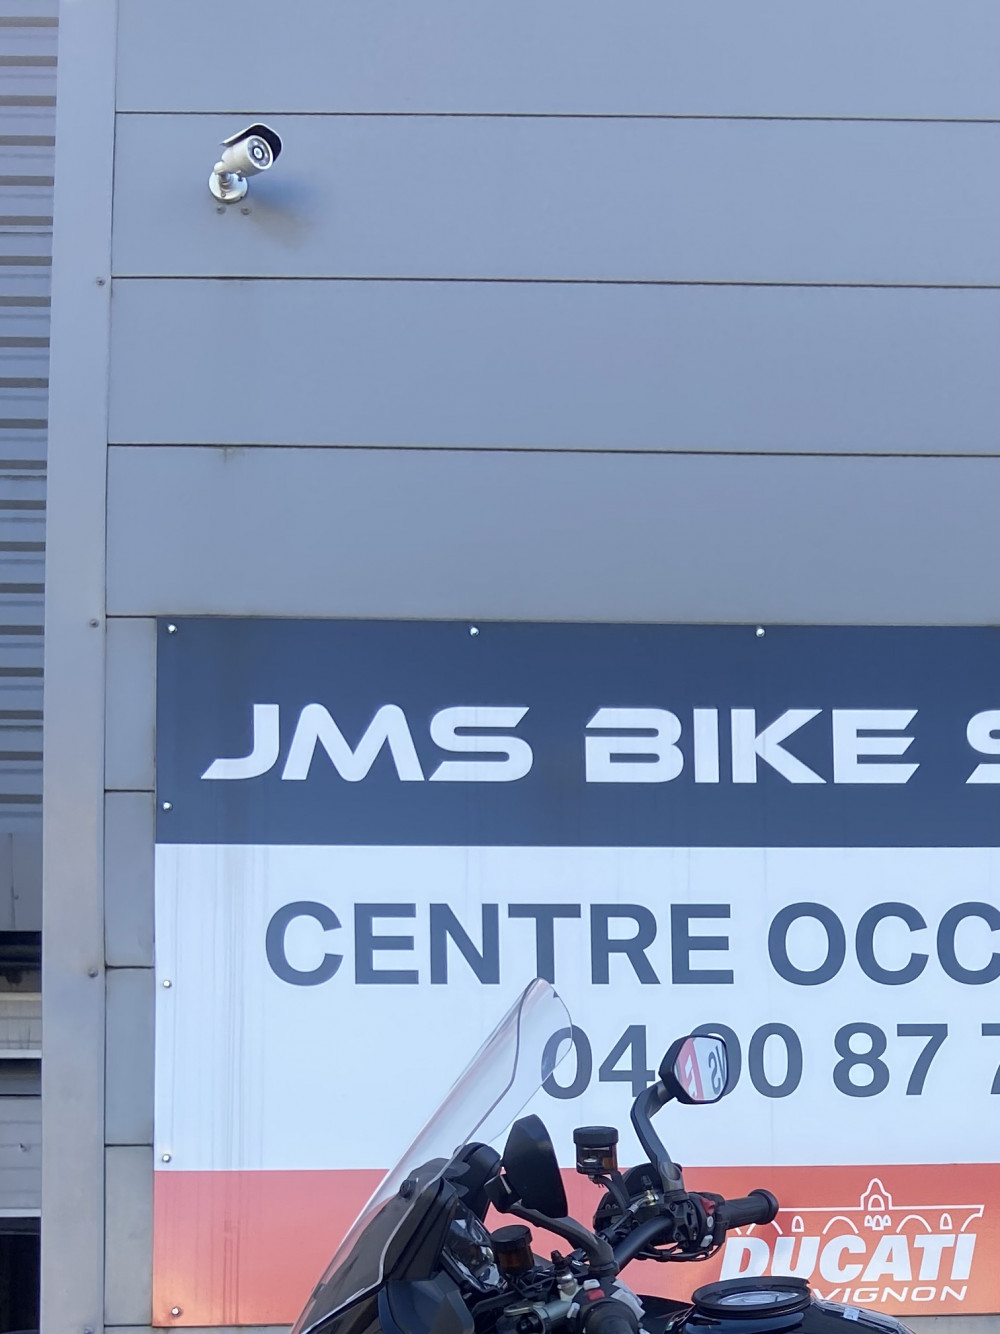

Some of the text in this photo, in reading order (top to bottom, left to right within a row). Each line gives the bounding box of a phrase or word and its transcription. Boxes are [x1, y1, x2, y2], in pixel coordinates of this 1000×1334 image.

[200, 703, 534, 782] JMS
[584, 707, 919, 784] BIKE
[265, 900, 735, 986] CENTRE
[540, 1023, 656, 1100] 04
[832, 1022, 948, 1098] 87
[719, 1233, 977, 1284] DUCATI
[812, 1285, 968, 1304] VIGNON
